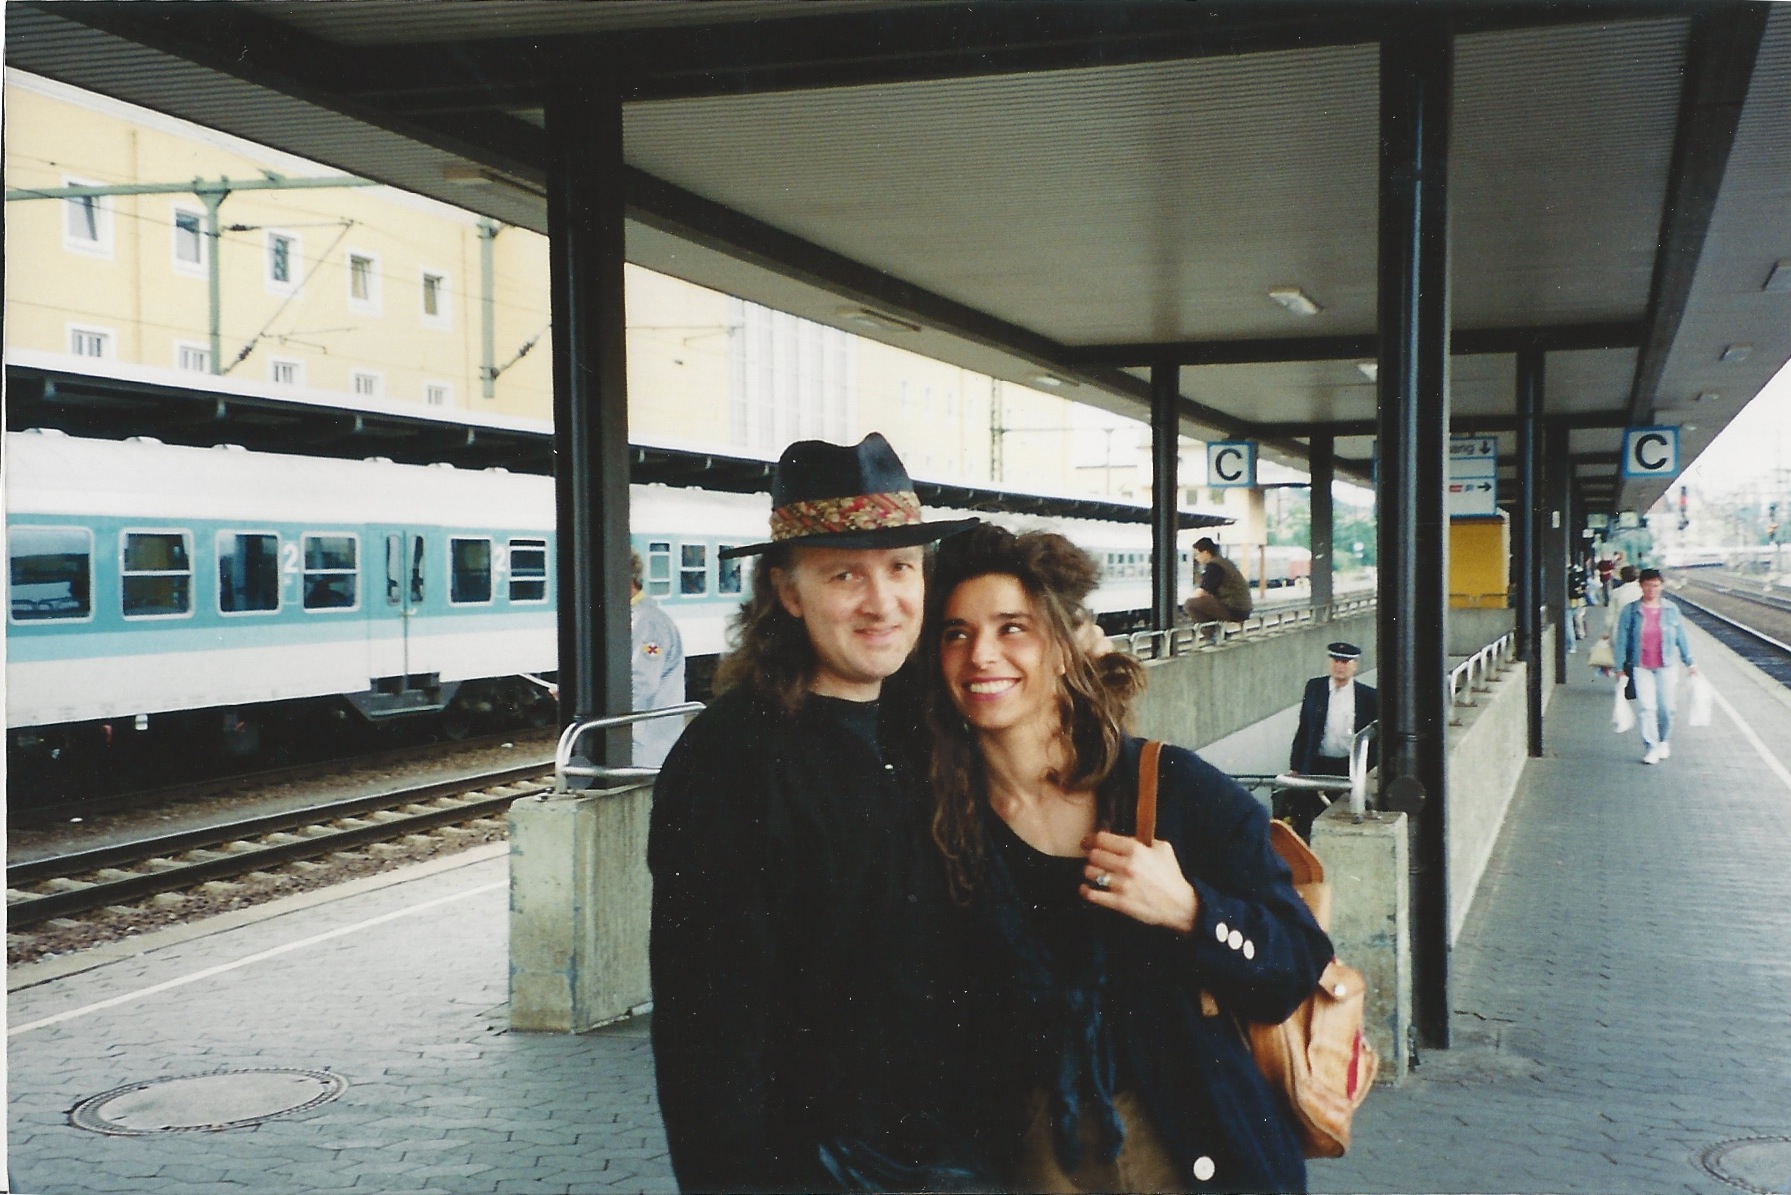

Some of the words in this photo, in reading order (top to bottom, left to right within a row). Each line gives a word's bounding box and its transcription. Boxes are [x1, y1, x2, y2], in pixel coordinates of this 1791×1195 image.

[1215, 448, 1242, 481] C
[1635, 433, 1668, 470] C
[283, 543, 299, 573] 2
[494, 546, 506, 572] 2
